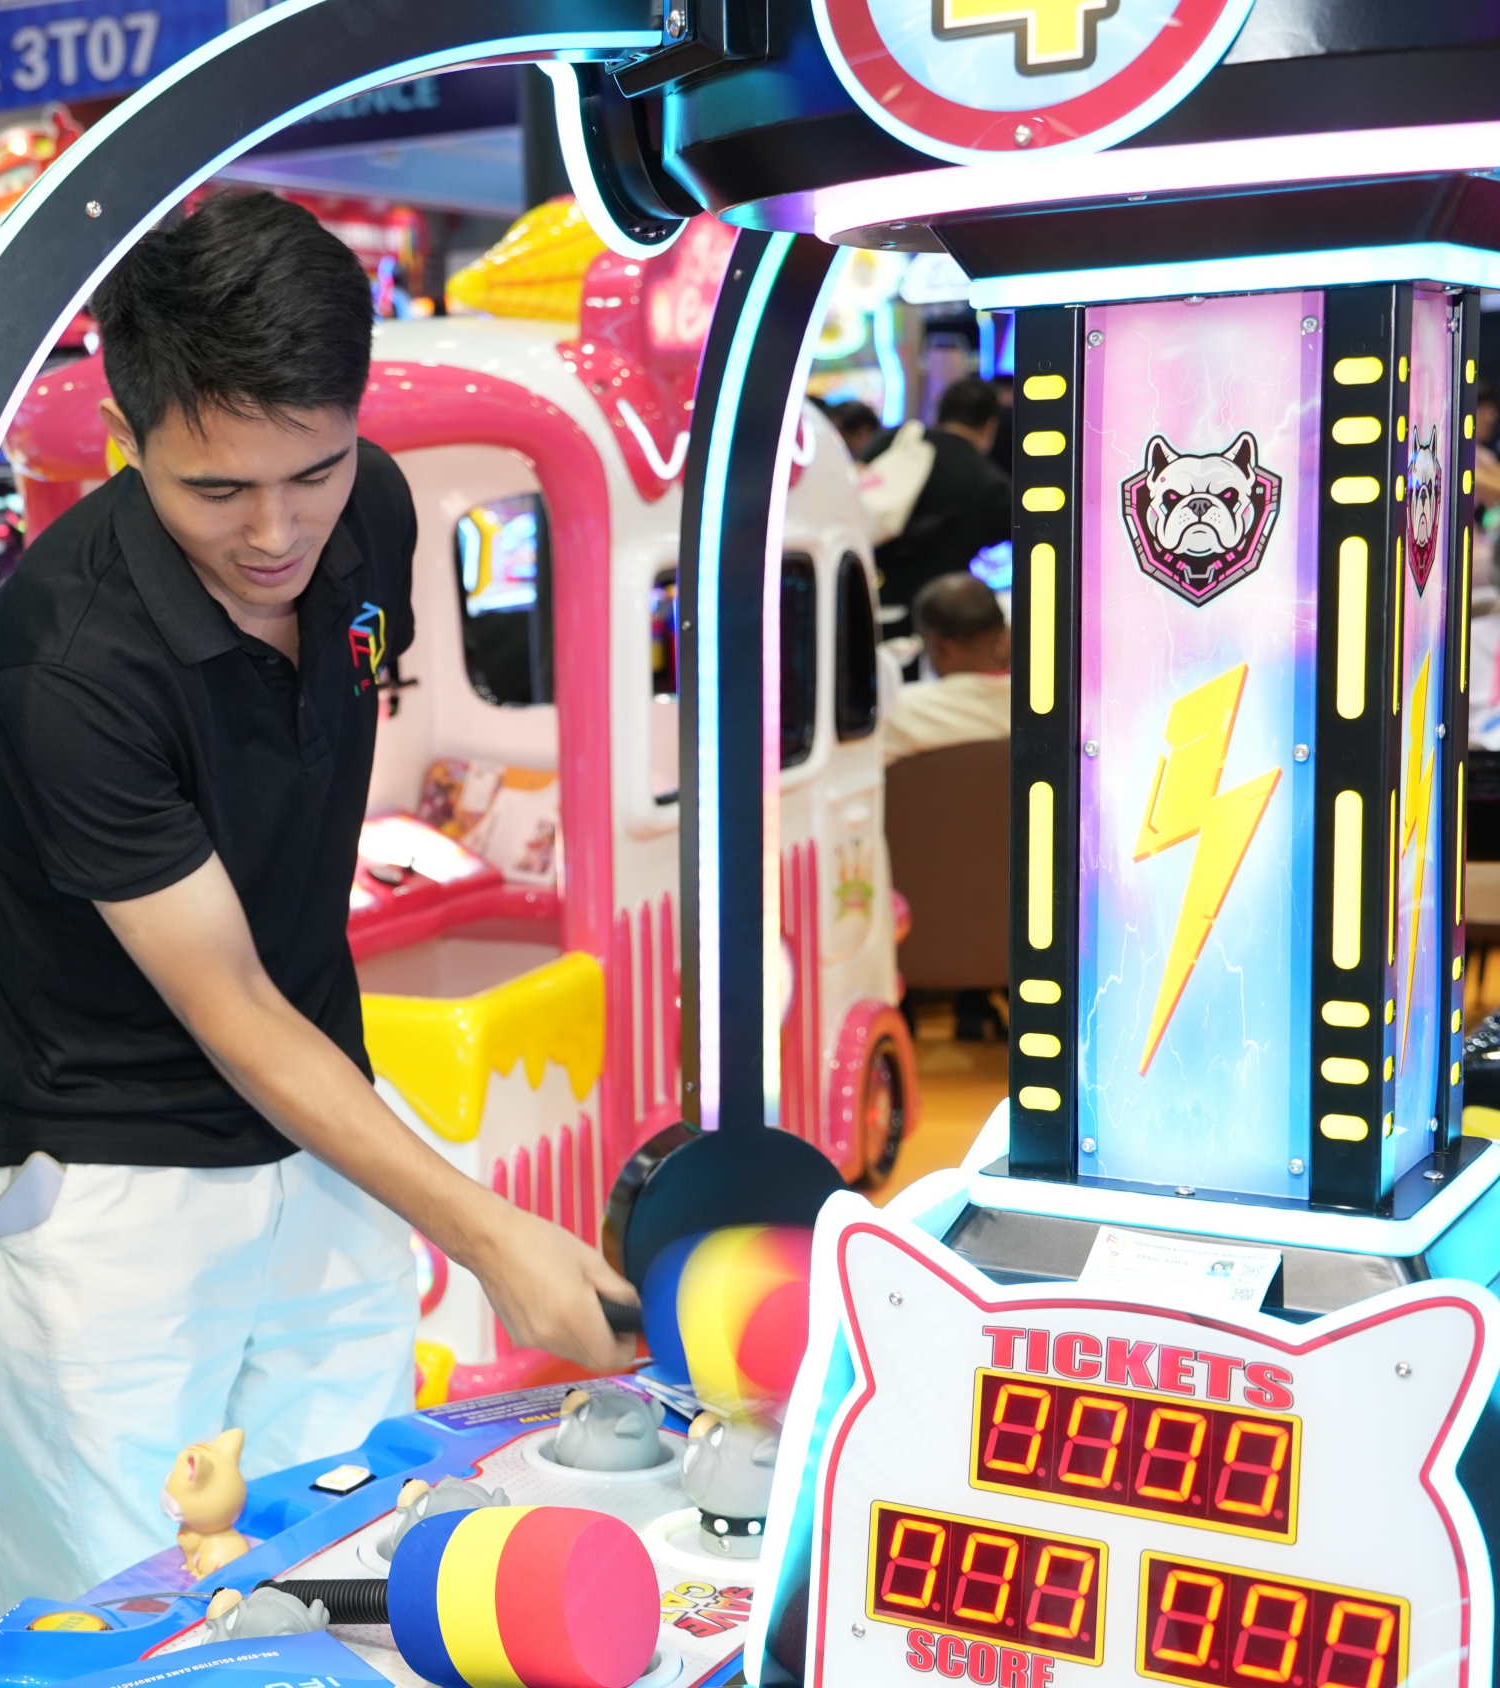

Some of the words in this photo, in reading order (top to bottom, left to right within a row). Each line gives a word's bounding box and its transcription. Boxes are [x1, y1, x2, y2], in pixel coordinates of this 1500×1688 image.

[982, 1325, 1295, 1411] TICKETS
[236, 1651, 279, 1662] ONE-STOP
[191, 1657, 235, 1671] SOLUTION
[165, 1667, 192, 1678] GAME
